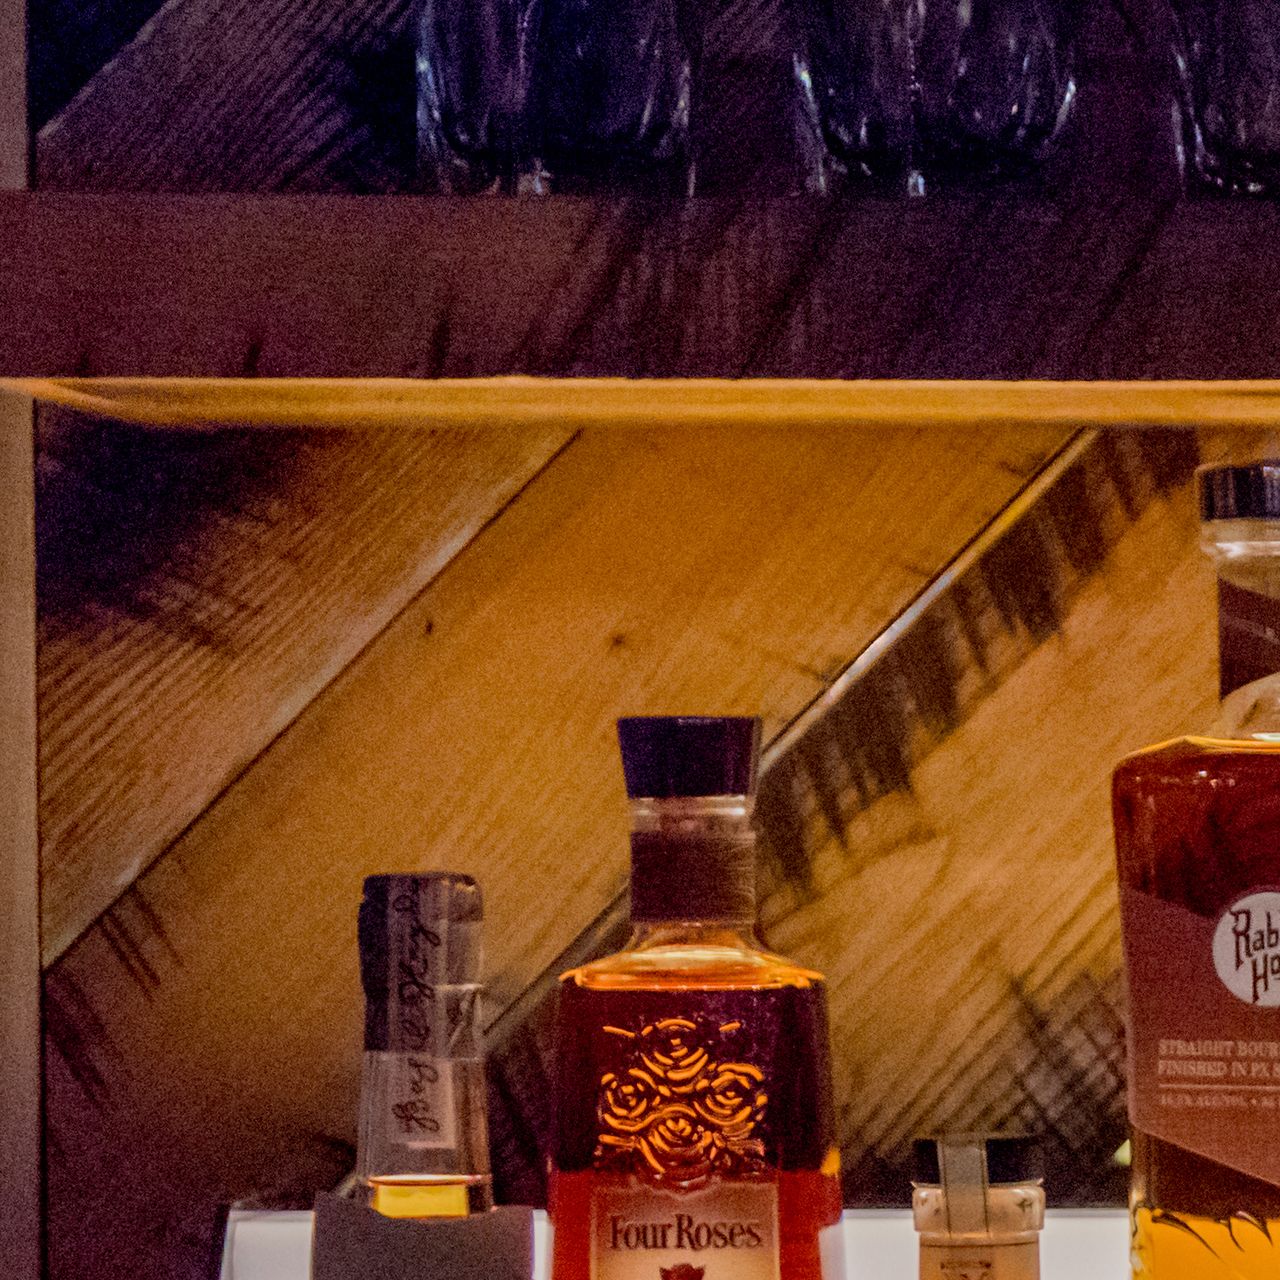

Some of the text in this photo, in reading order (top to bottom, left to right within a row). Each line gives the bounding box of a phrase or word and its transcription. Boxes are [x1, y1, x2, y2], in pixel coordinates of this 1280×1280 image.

[1159, 1040, 1233, 1056] STRAIGHT
[1158, 1060, 1227, 1077] FINISHED
[1231, 1062, 1247, 1077] IN
[610, 1213, 763, 1250] Four Roses
